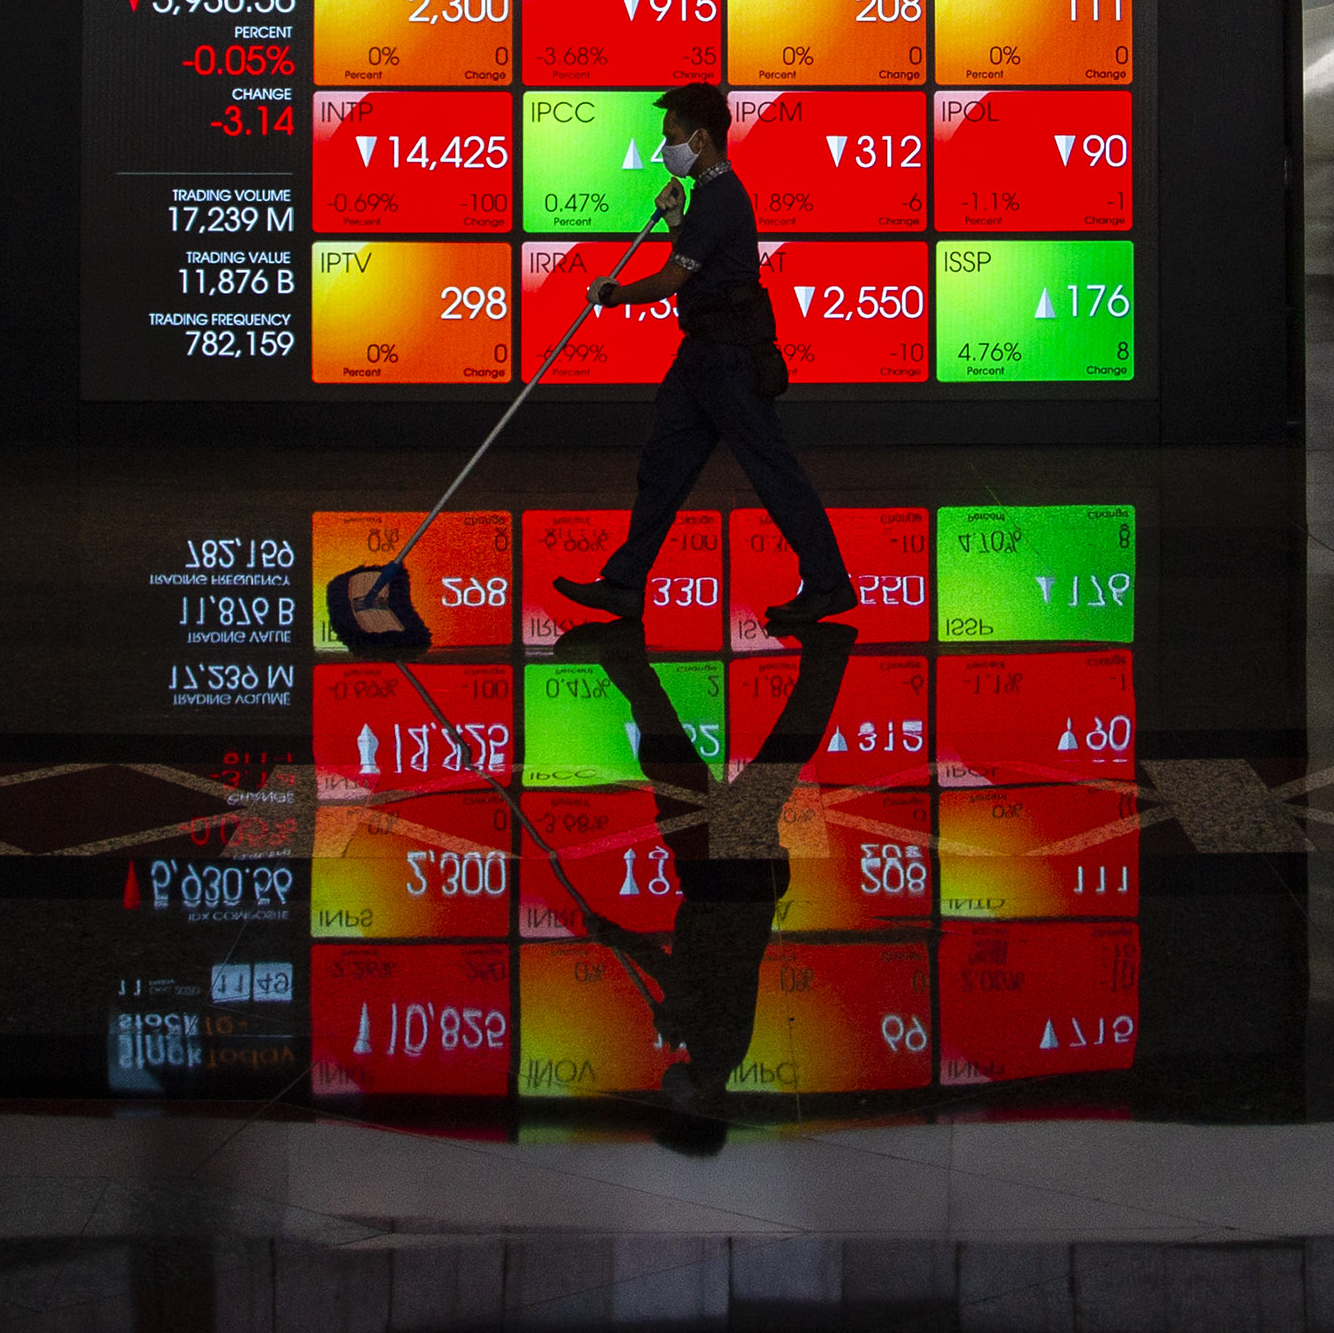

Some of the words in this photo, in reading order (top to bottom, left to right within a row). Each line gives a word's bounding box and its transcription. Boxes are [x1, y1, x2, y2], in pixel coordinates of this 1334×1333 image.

[235, 27, 293, 39] PERCENT
[183, 45, 295, 76] -0.05%
[368, 46, 400, 66] 0%
[495, 46, 509, 66] 0
[536, 47, 608, 66] -3.68%
[683, 47, 716, 66] -35
[782, 46, 814, 66] 0%
[909, 46, 922, 66] 0
[990, 46, 1021, 65] 0%
[1116, 46, 1128, 65] 0
[345, 70, 382, 80] Percent
[465, 70, 506, 81] Change
[552, 70, 590, 80] Percent
[673, 70, 714, 81] Change
[759, 69, 797, 80] Percent
[879, 69, 920, 81] Change
[966, 69, 1004, 79] Percent
[1086, 69, 1126, 81] Change
[232, 88, 292, 100] CHANGE
[210, 106, 294, 136] -3.14
[321, 102, 373, 123] INTP
[531, 101, 595, 123] IPCC
[735, 101, 803, 123] IPCM
[942, 101, 999, 123] IPOL
[389, 136, 508, 171] 14,425
[856, 135, 921, 168] 312
[1083, 135, 1127, 167] 90
[172, 190, 231, 202] TRADING
[233, 190, 291, 202] VOLUME
[327, 194, 398, 213] -0.69%
[460, 194, 508, 213] -100
[545, 194, 609, 213] 0.47%
[751, 193, 814, 213] 1.89%
[902, 193, 922, 213] -6
[962, 193, 1020, 212] -1.1%
[1107, 193, 1125, 212] -1
[169, 207, 258, 234] 17,239
[268, 207, 294, 232] M
[343, 217, 380, 226] Percent
[464, 217, 505, 228] Change
[554, 217, 591, 227] Percent
[759, 217, 796, 227] Percent
[879, 216, 919, 228] Change
[965, 216, 1003, 226] Percent
[1085, 216, 1124, 227] Change
[187, 252, 245, 264] TRADING
[247, 252, 291, 264] VALUE
[321, 253, 372, 273] IPTV
[530, 252, 587, 275] IRRA
[944, 251, 992, 273] ISSP
[180, 269, 268, 297] 11,876
[278, 269, 294, 294] B
[441, 286, 507, 321] 298
[823, 285, 923, 321] 2,550
[1067, 284, 1130, 318] 176
[149, 314, 207, 325] TRADING
[210, 314, 291, 326] FREQUENCY
[185, 331, 295, 358] 782,159
[367, 344, 398, 363] 0%
[494, 344, 507, 363] 0
[890, 343, 924, 362] -10
[958, 343, 1022, 362] 4.76%
[1117, 342, 1129, 361] 8
[343, 368, 381, 377] Percent
[464, 368, 505, 379] Change
[552, 367, 590, 378] Percent
[880, 367, 921, 378] Change
[967, 366, 1005, 376] Percent
[1087, 365, 1127, 377] Change
